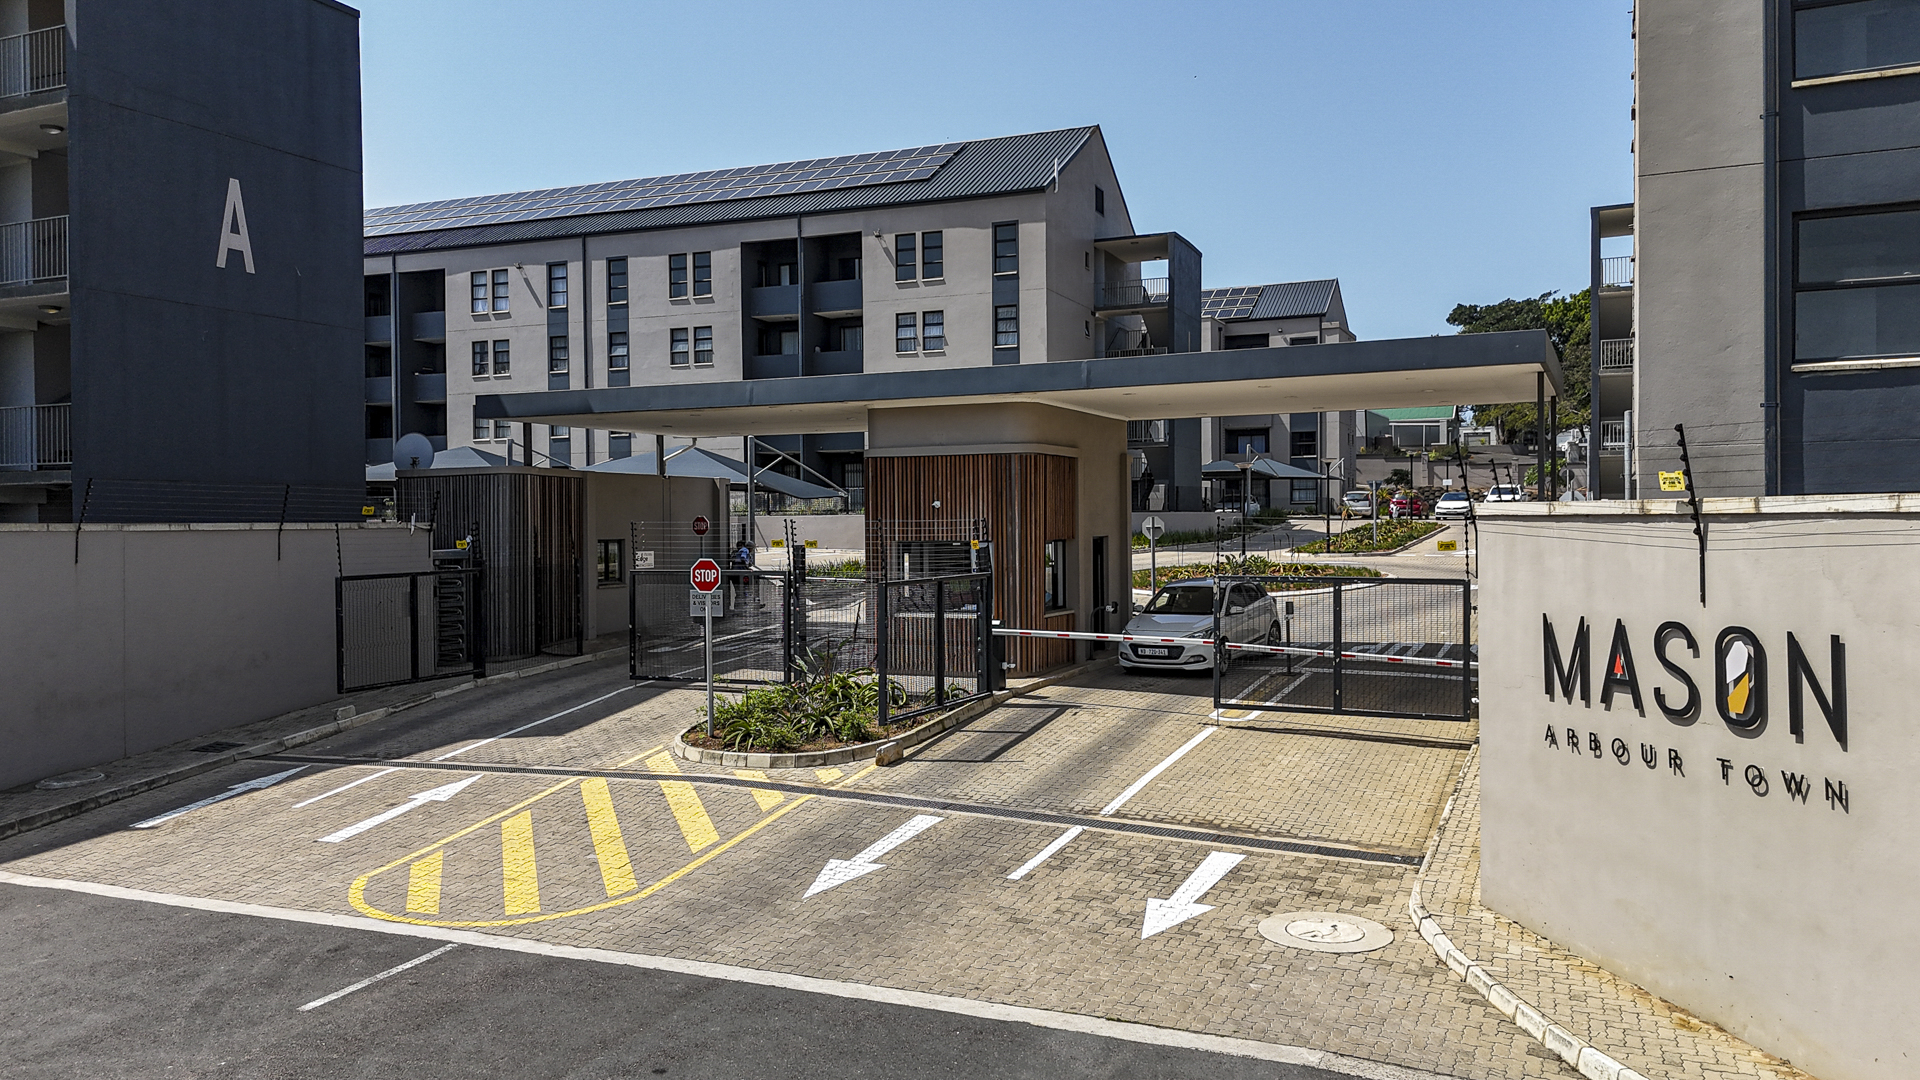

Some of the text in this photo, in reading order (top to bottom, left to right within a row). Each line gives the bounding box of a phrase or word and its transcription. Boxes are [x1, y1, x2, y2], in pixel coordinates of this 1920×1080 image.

[216, 177, 255, 274] A
[694, 521, 708, 530] STOP
[694, 569, 718, 582] STOP
[1543, 613, 1846, 744] MASON
[1545, 724, 1682, 772] ARBOUR
[1716, 757, 1847, 805] TOWN
